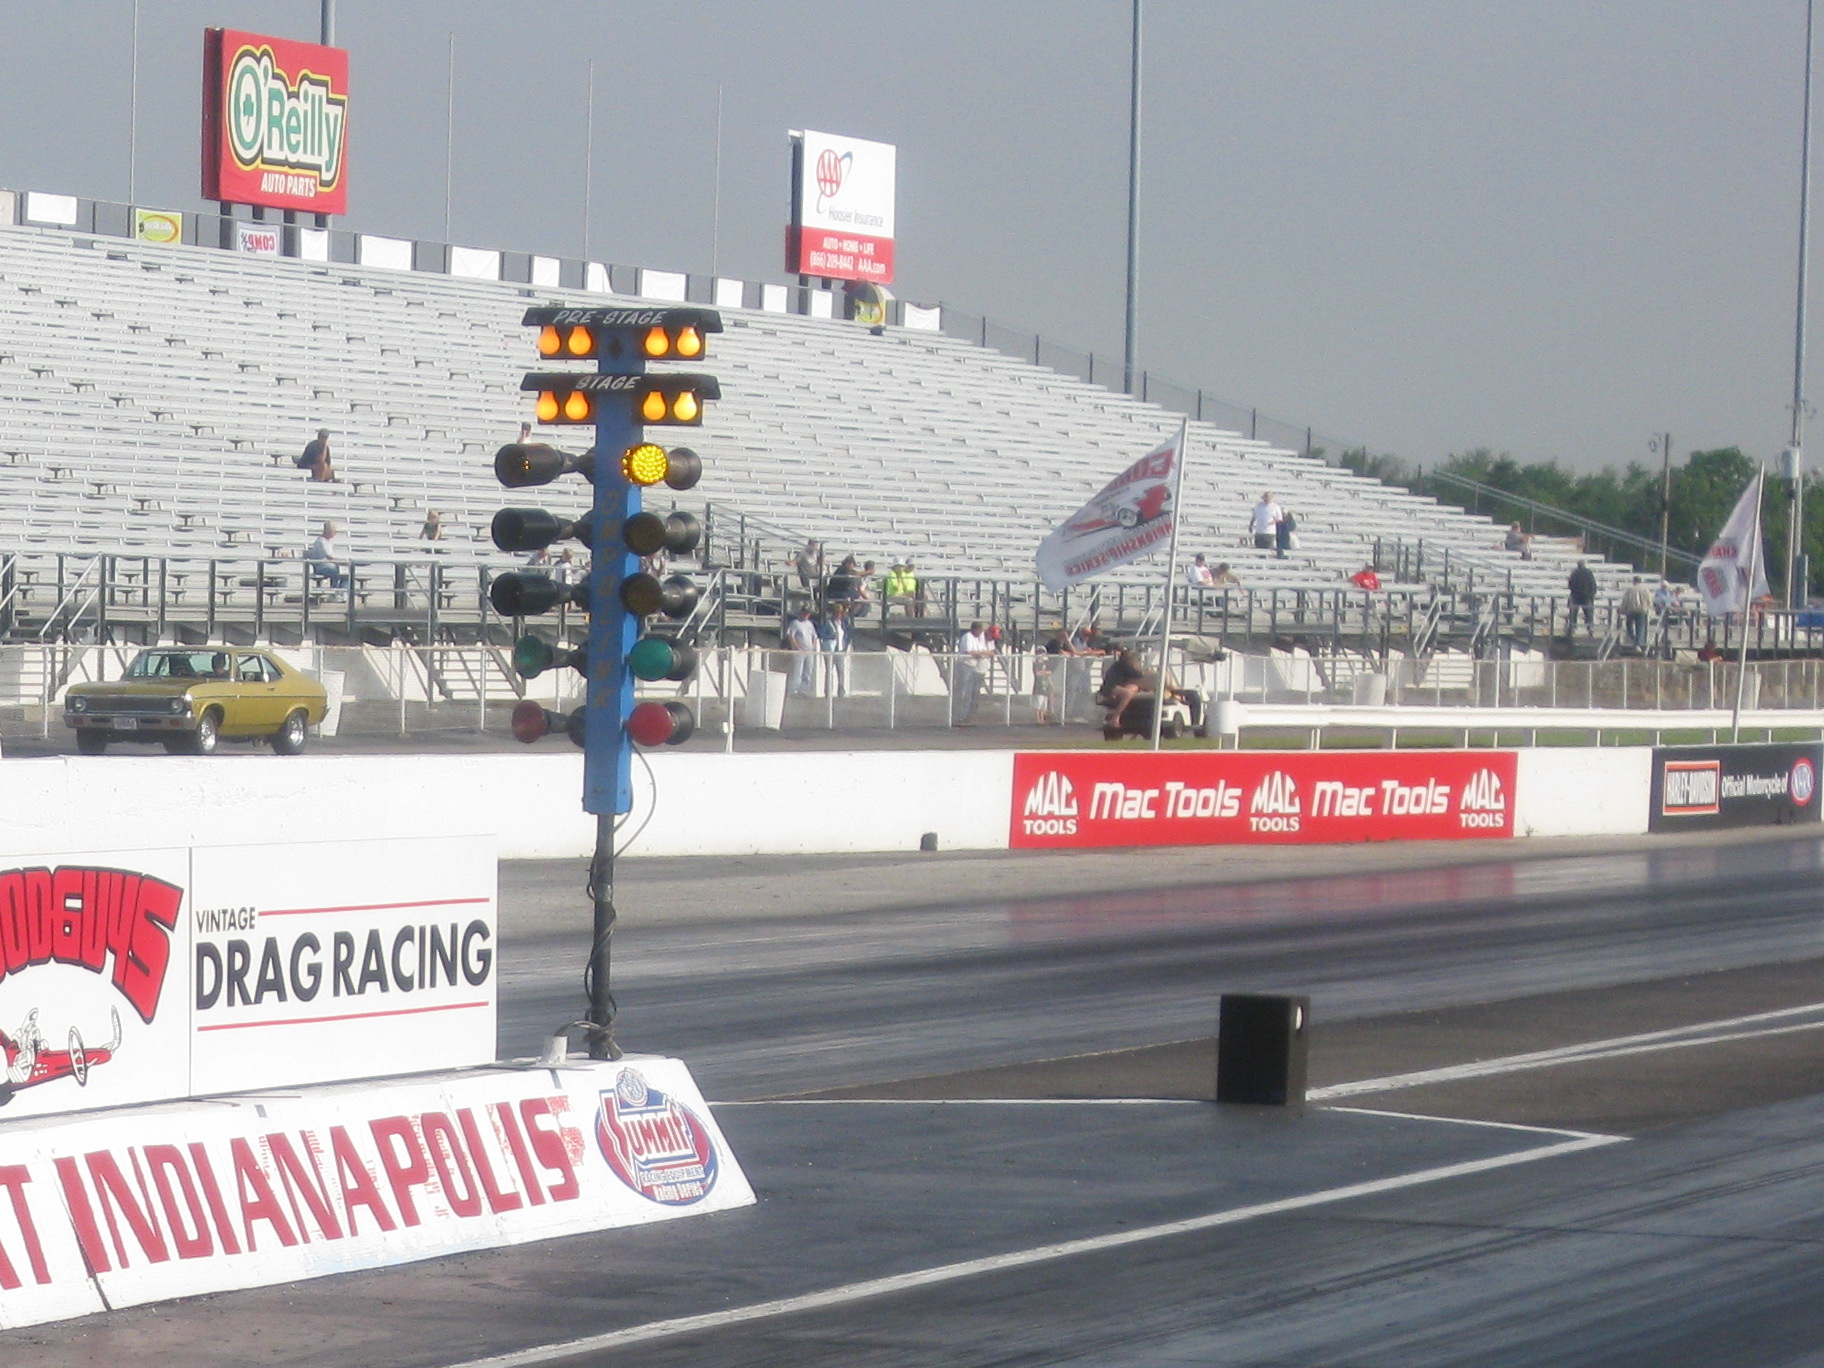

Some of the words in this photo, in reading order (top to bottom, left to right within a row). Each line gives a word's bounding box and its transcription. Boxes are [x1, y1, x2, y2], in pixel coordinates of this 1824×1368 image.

[232, 59, 341, 175] O'Reilly
[260, 173, 285, 193] AUTO
[286, 175, 316, 197] PARTS
[553, 309, 668, 325] PRE-STAGE
[575, 375, 641, 390] STAGE
[1024, 771, 1078, 816] MAC
[1165, 779, 1242, 818] Tools
[1251, 771, 1301, 813] MAC
[1381, 777, 1451, 815] Tools
[1461, 768, 1505, 809] MAC
[1023, 819, 1077, 835] TOOLS
[1250, 816, 1300, 832] TOOLS
[1460, 813, 1504, 828] TOOLS
[196, 906, 255, 933] VINTAGE
[196, 931, 323, 1011] DRAG
[333, 919, 492, 998] RACING
[602, 1096, 691, 1170] SUMMIT
[52, 1095, 582, 1279] INDIANAPOLIS
